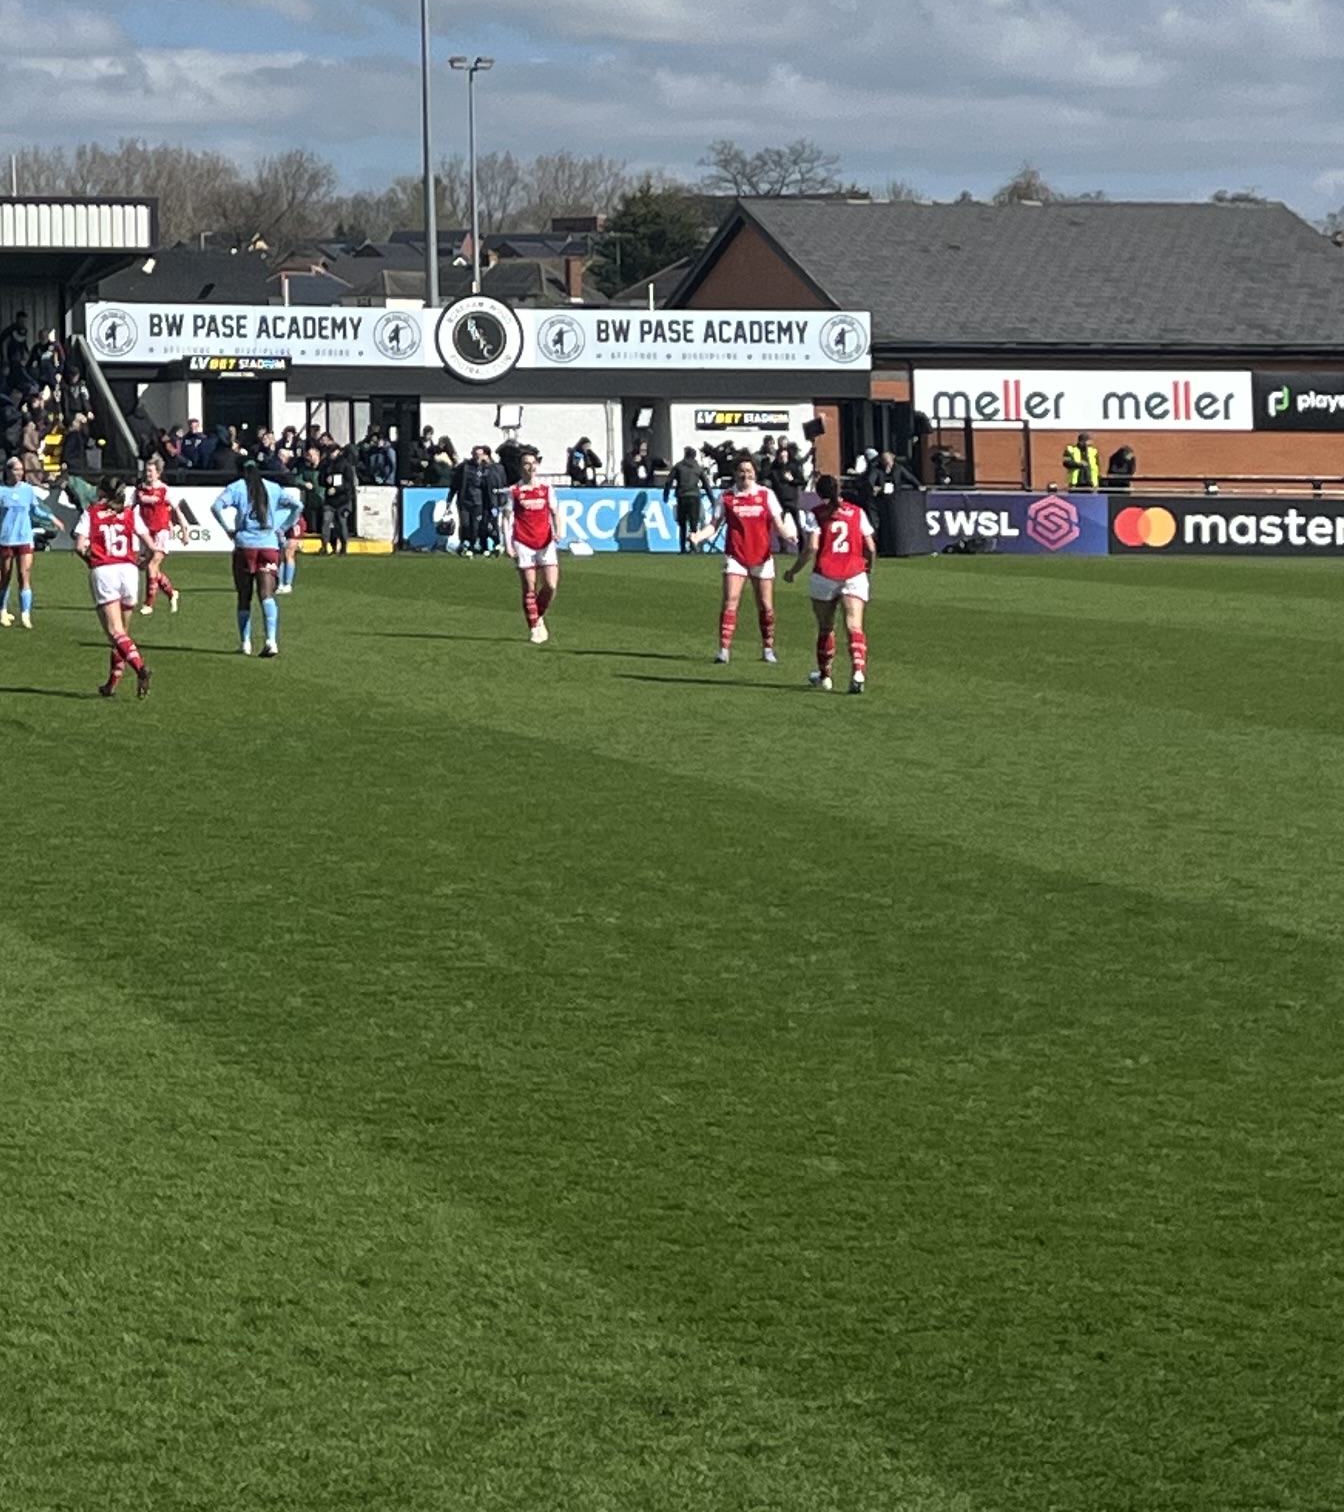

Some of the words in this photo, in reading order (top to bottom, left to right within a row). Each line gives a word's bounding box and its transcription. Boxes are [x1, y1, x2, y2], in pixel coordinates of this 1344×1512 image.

[149, 313, 184, 337] BW
[193, 314, 247, 338] PASE
[256, 316, 362, 340] ACADEMY
[596, 319, 630, 343] BW
[639, 319, 694, 343] PASE
[703, 320, 808, 344] ACADEMY
[933, 380, 1064, 420] meller
[1103, 381, 1234, 420] meller
[831, 520, 849, 553] 2
[944, 510, 1019, 536] WSL
[99, 523, 128, 557] 15
